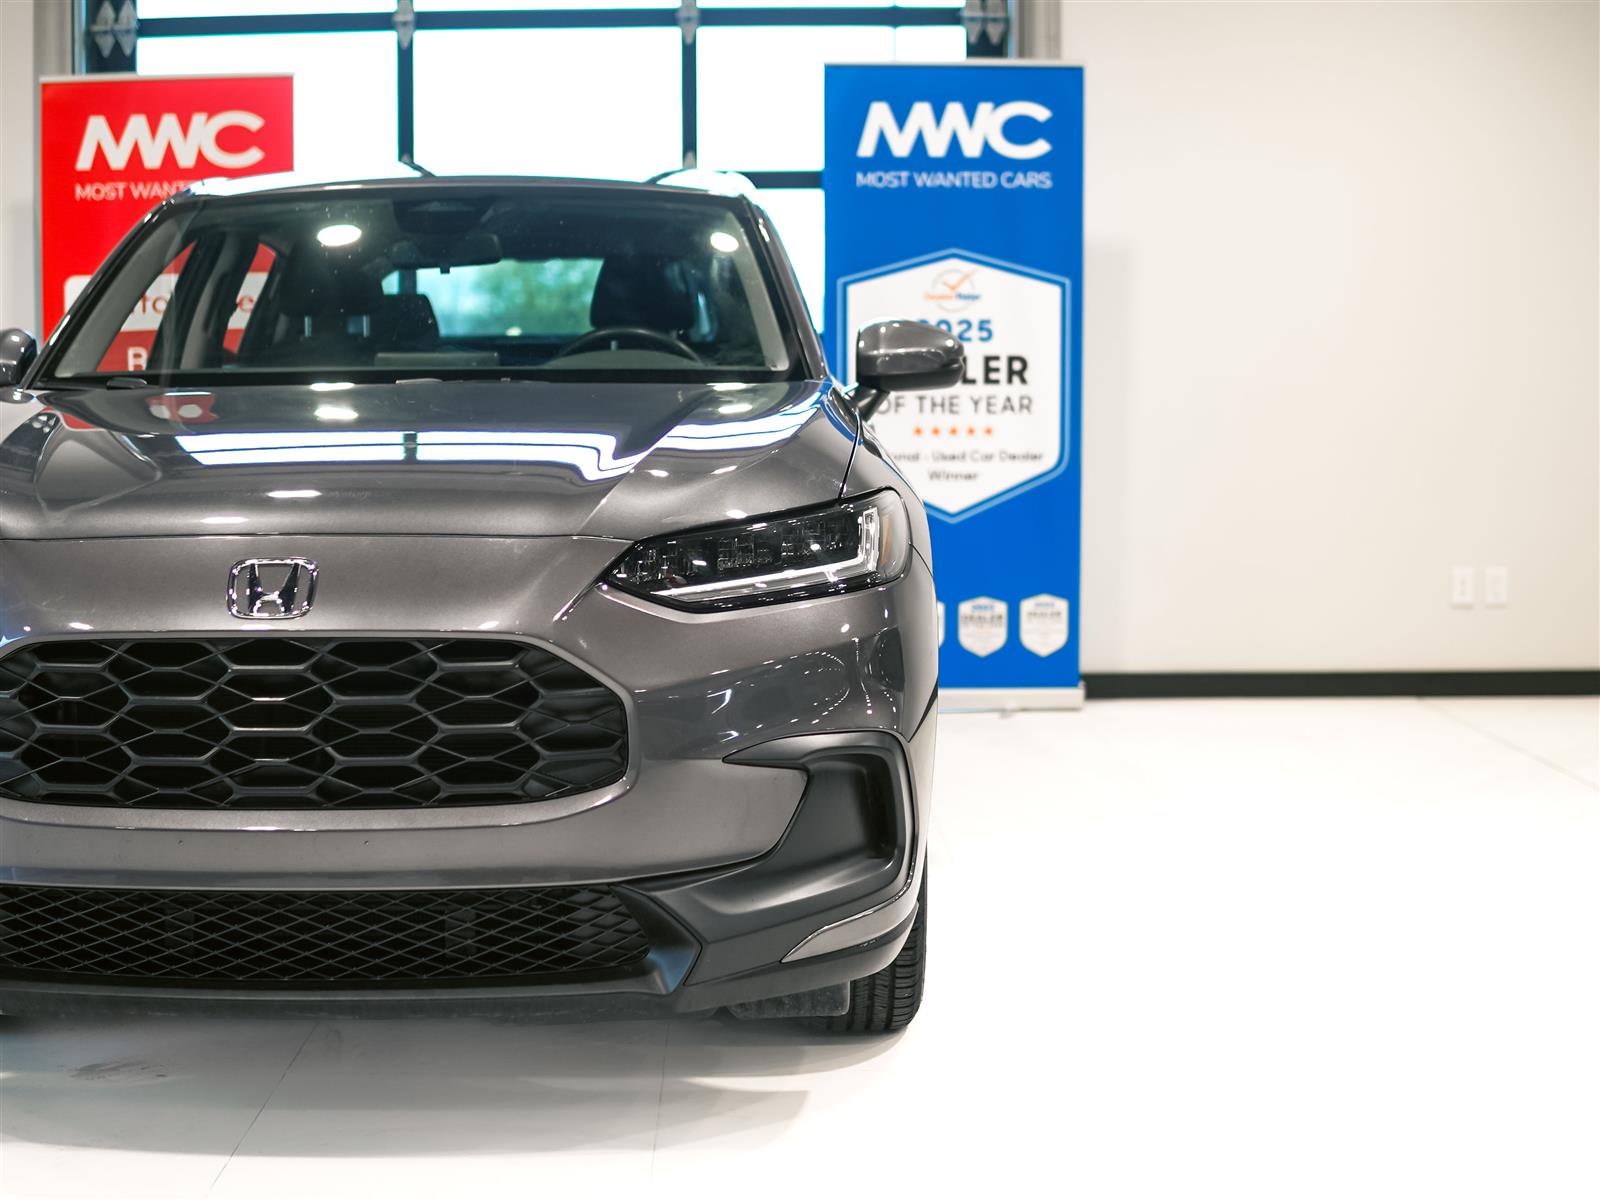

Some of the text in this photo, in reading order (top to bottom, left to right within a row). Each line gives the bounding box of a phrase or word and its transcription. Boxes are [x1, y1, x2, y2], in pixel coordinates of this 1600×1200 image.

[856, 100, 1053, 160] MWC
[75, 110, 265, 171] MWC
[856, 171, 1053, 189] MOST WANTED CARS
[75, 181, 188, 201] MOST WANT
[917, 318, 993, 342] 25
[961, 355, 1028, 385] LER
[877, 395, 1033, 415] OF THE YEAR
[932, 450, 967, 463] Used
[969, 450, 994, 463] Car
[999, 450, 1044, 463] Dealer
[928, 470, 978, 482] Winner
